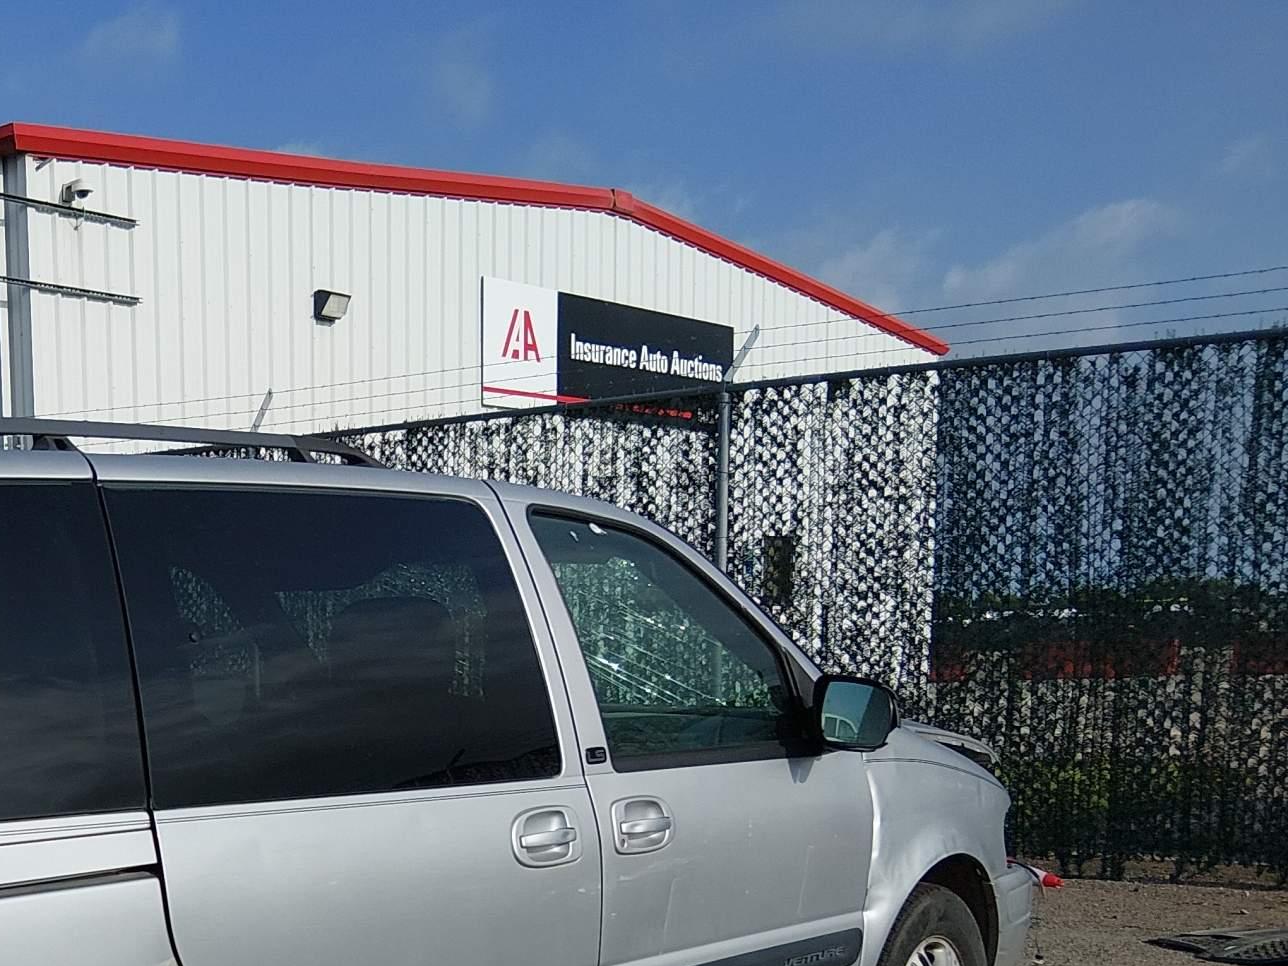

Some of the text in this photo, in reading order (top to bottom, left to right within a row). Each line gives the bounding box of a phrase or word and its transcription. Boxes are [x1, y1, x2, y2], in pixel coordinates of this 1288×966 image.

[570, 332, 723, 382] Insurance Auto Auctions
